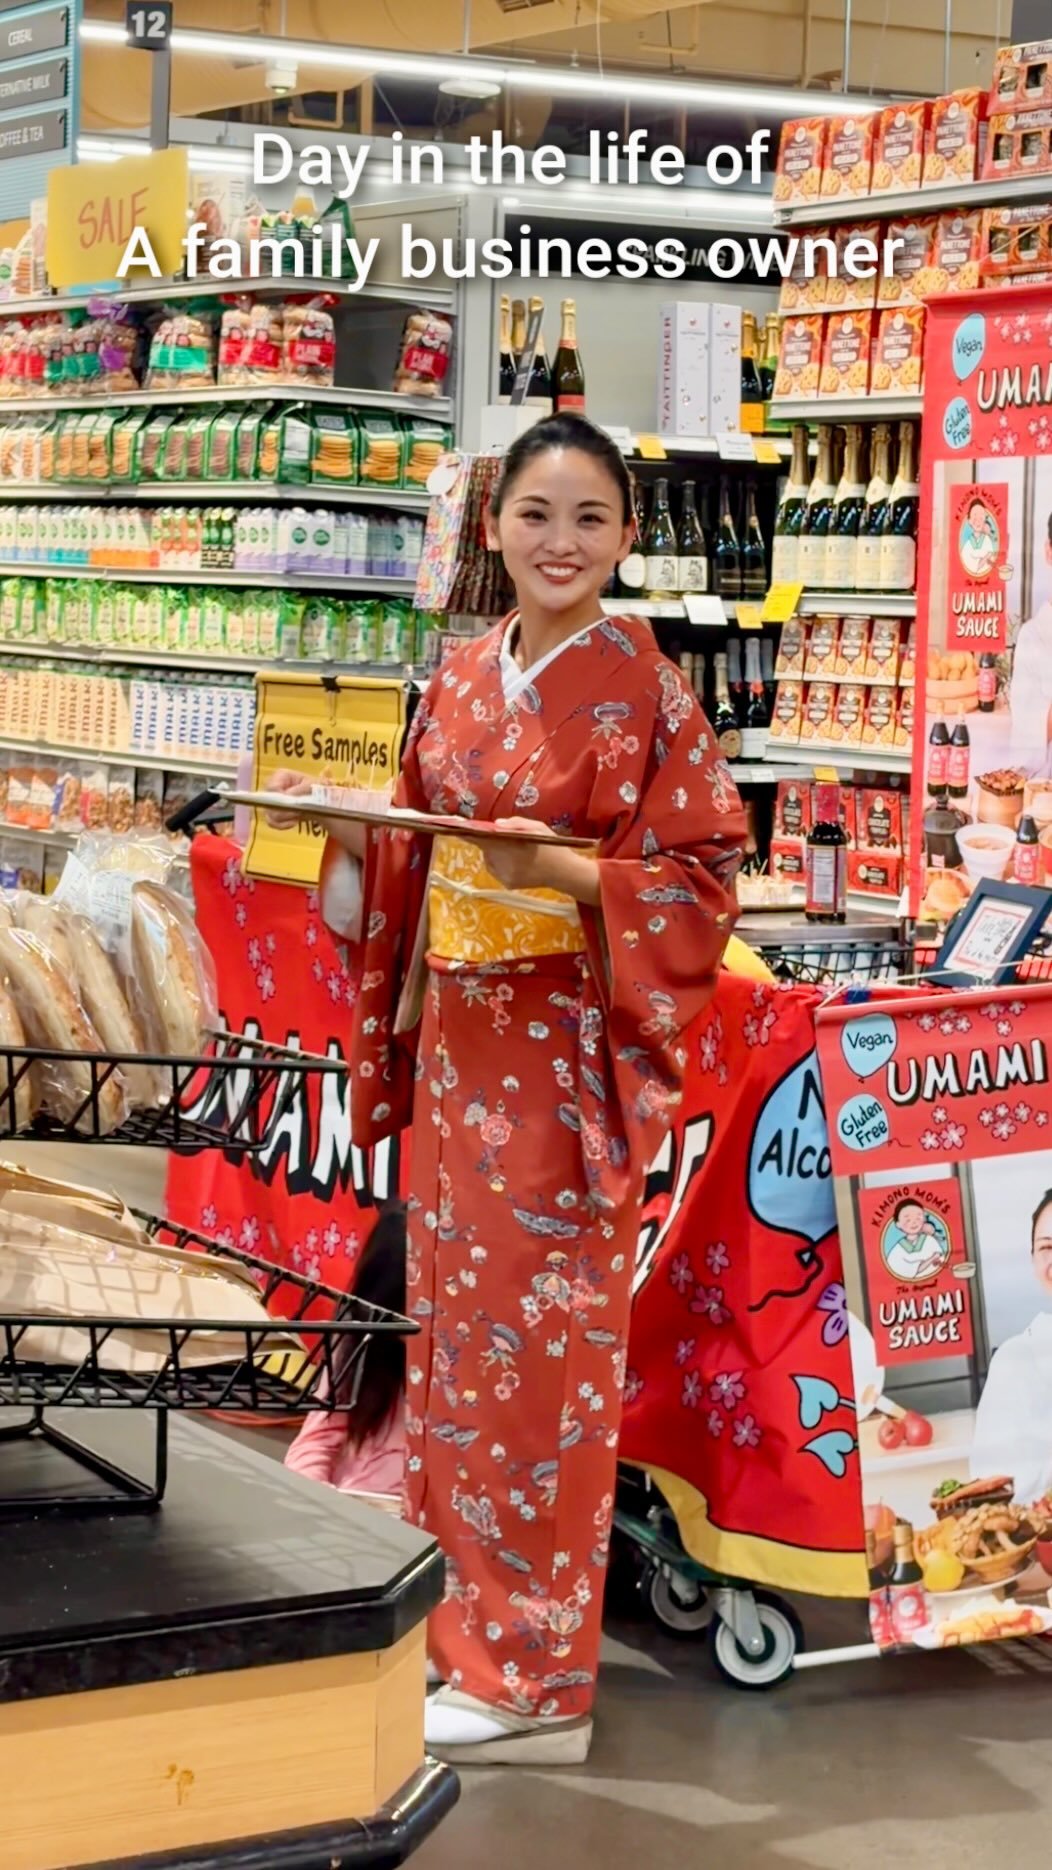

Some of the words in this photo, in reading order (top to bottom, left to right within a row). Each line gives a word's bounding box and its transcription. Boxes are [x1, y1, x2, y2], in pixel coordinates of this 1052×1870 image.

[8, 28, 33, 47] CEREAL
[131, 10, 166, 38] 12
[30, 126, 44, 142] TEA
[955, 338, 983, 356] Vegan
[952, 423, 971, 446] Free
[952, 590, 1004, 616] UMAMI
[956, 616, 1000, 640] SAUCE
[263, 723, 306, 759] Free
[311, 727, 388, 775] Samples
[846, 1031, 894, 1052] Vegan
[886, 1038, 1049, 1107] UMAMI
[840, 1101, 883, 1136] Gluten
[855, 1120, 888, 1148] Free
[871, 1186, 910, 1228] KIMONO
[914, 1187, 951, 1216] MOM'S
[879, 1289, 965, 1328] UMAMI
[888, 1317, 962, 1351] SAUCE
